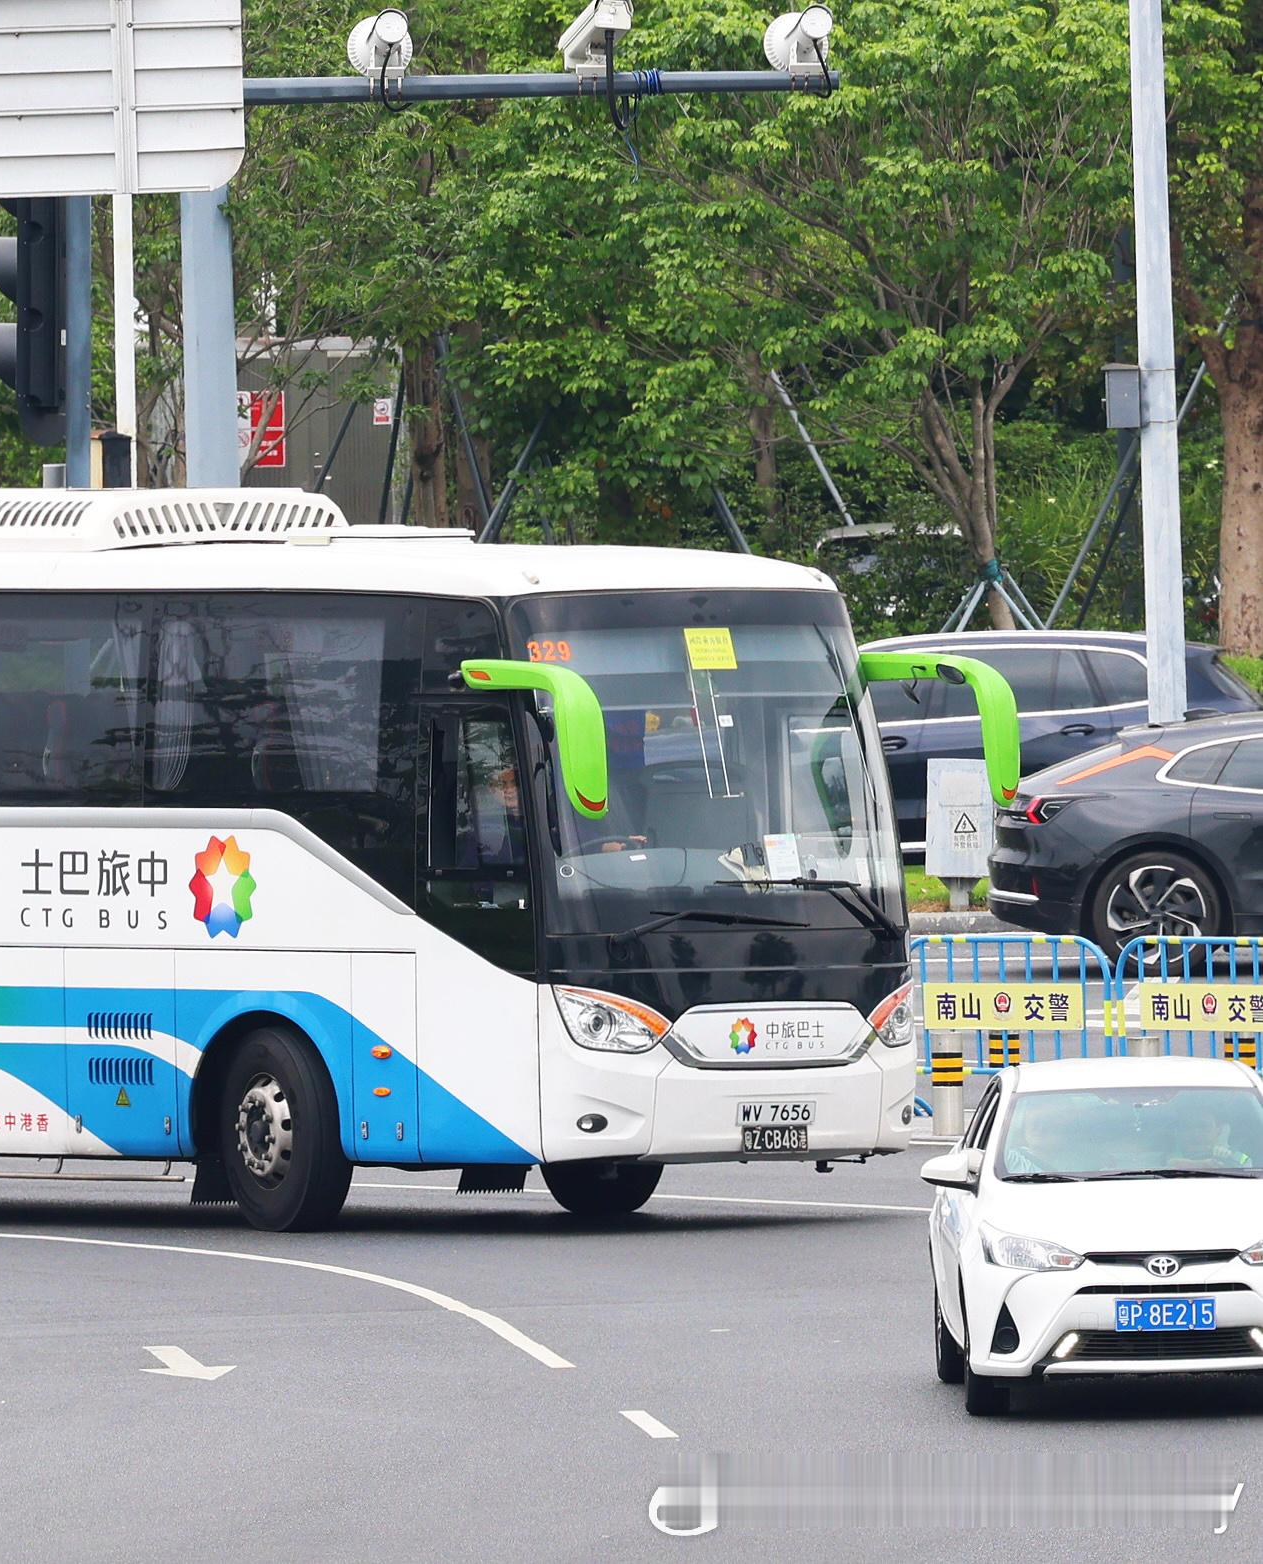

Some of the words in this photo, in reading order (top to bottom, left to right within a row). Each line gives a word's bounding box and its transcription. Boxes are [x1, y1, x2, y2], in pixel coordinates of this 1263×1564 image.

[527, 639, 571, 662] 329
[20, 907, 74, 928] CTG
[98, 909, 168, 930] BUS
[936, 992, 981, 1021] 南山
[1024, 993, 1069, 1022] 交警
[1151, 993, 1191, 1022] 南山
[766, 1020, 825, 1039] 中旅巴士
[765, 1041, 789, 1050] CTG
[797, 1040, 825, 1050] BUS
[741, 1105, 762, 1122] WV
[771, 1104, 811, 1122] 7656
